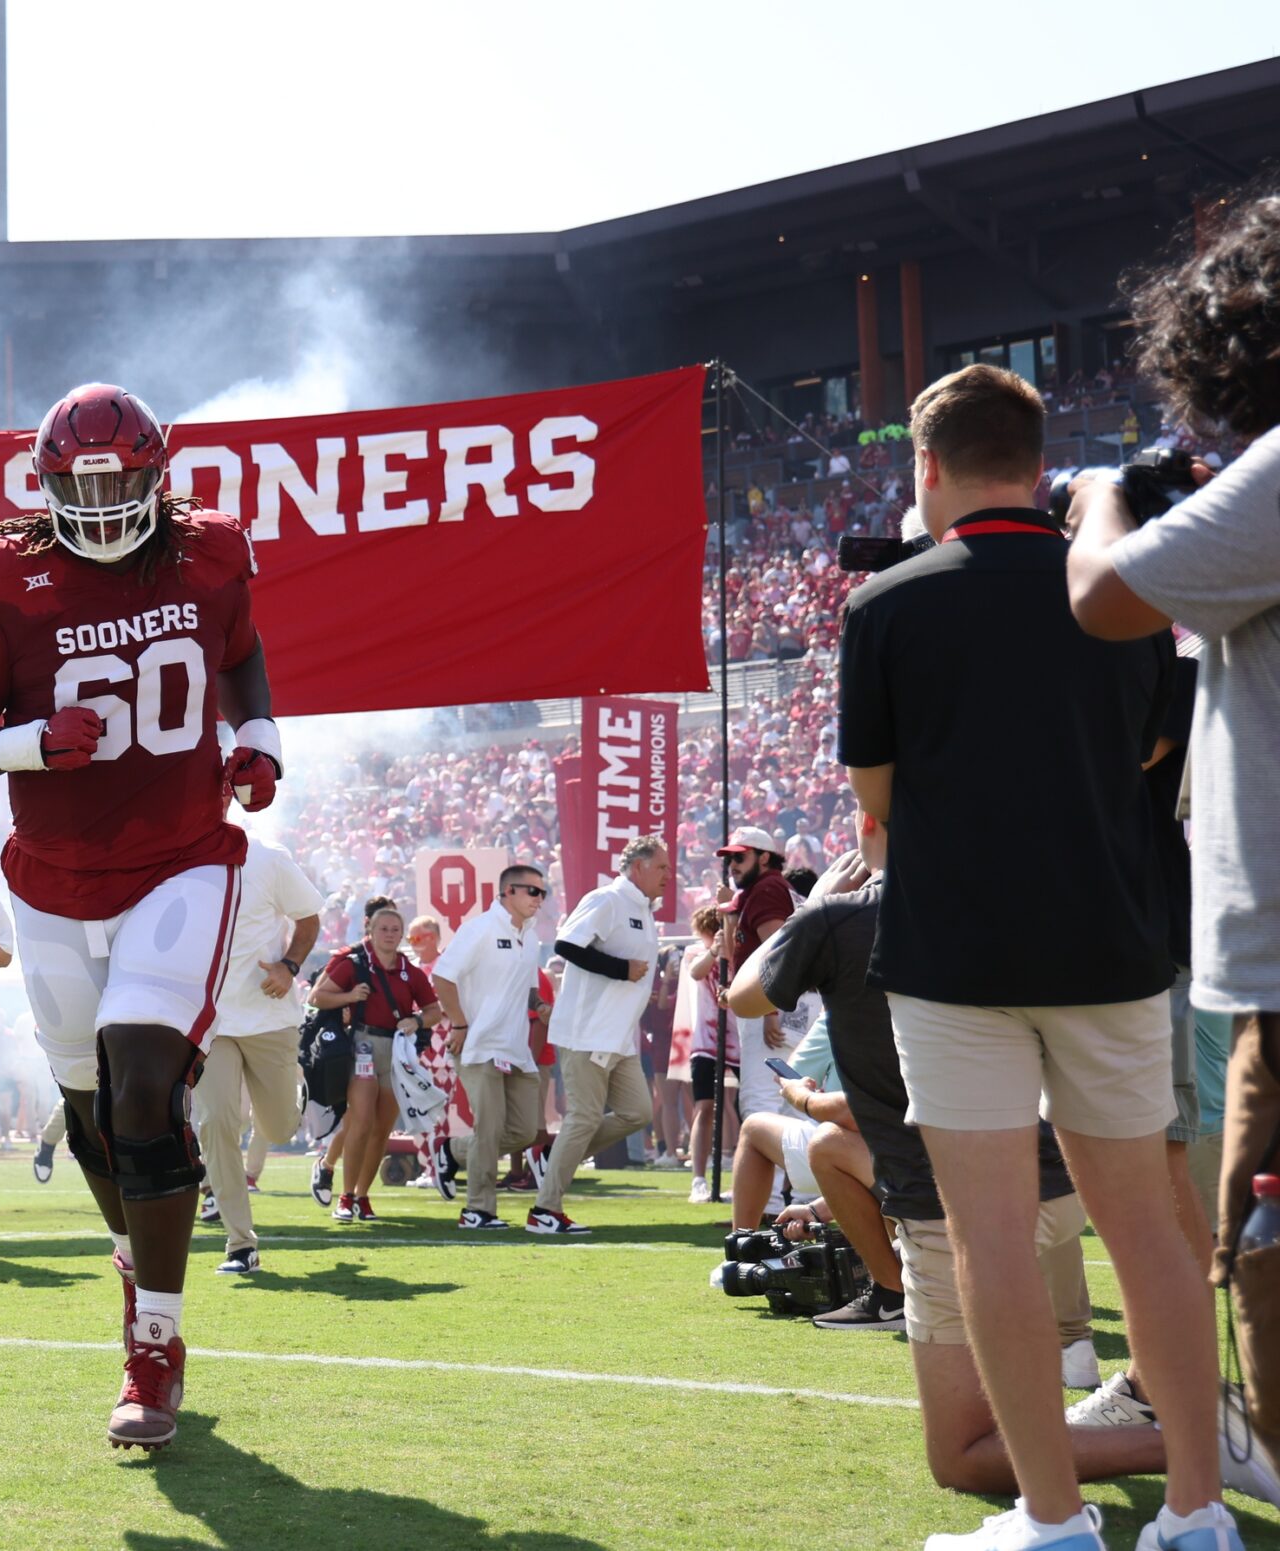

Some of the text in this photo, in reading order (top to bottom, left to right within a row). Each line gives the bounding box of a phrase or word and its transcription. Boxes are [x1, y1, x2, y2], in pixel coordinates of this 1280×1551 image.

[56, 603, 198, 654] SOONERS
[53, 637, 207, 761] 60
[649, 713, 665, 816] CHAMPIONS
[149, 1322, 162, 1339] OU
